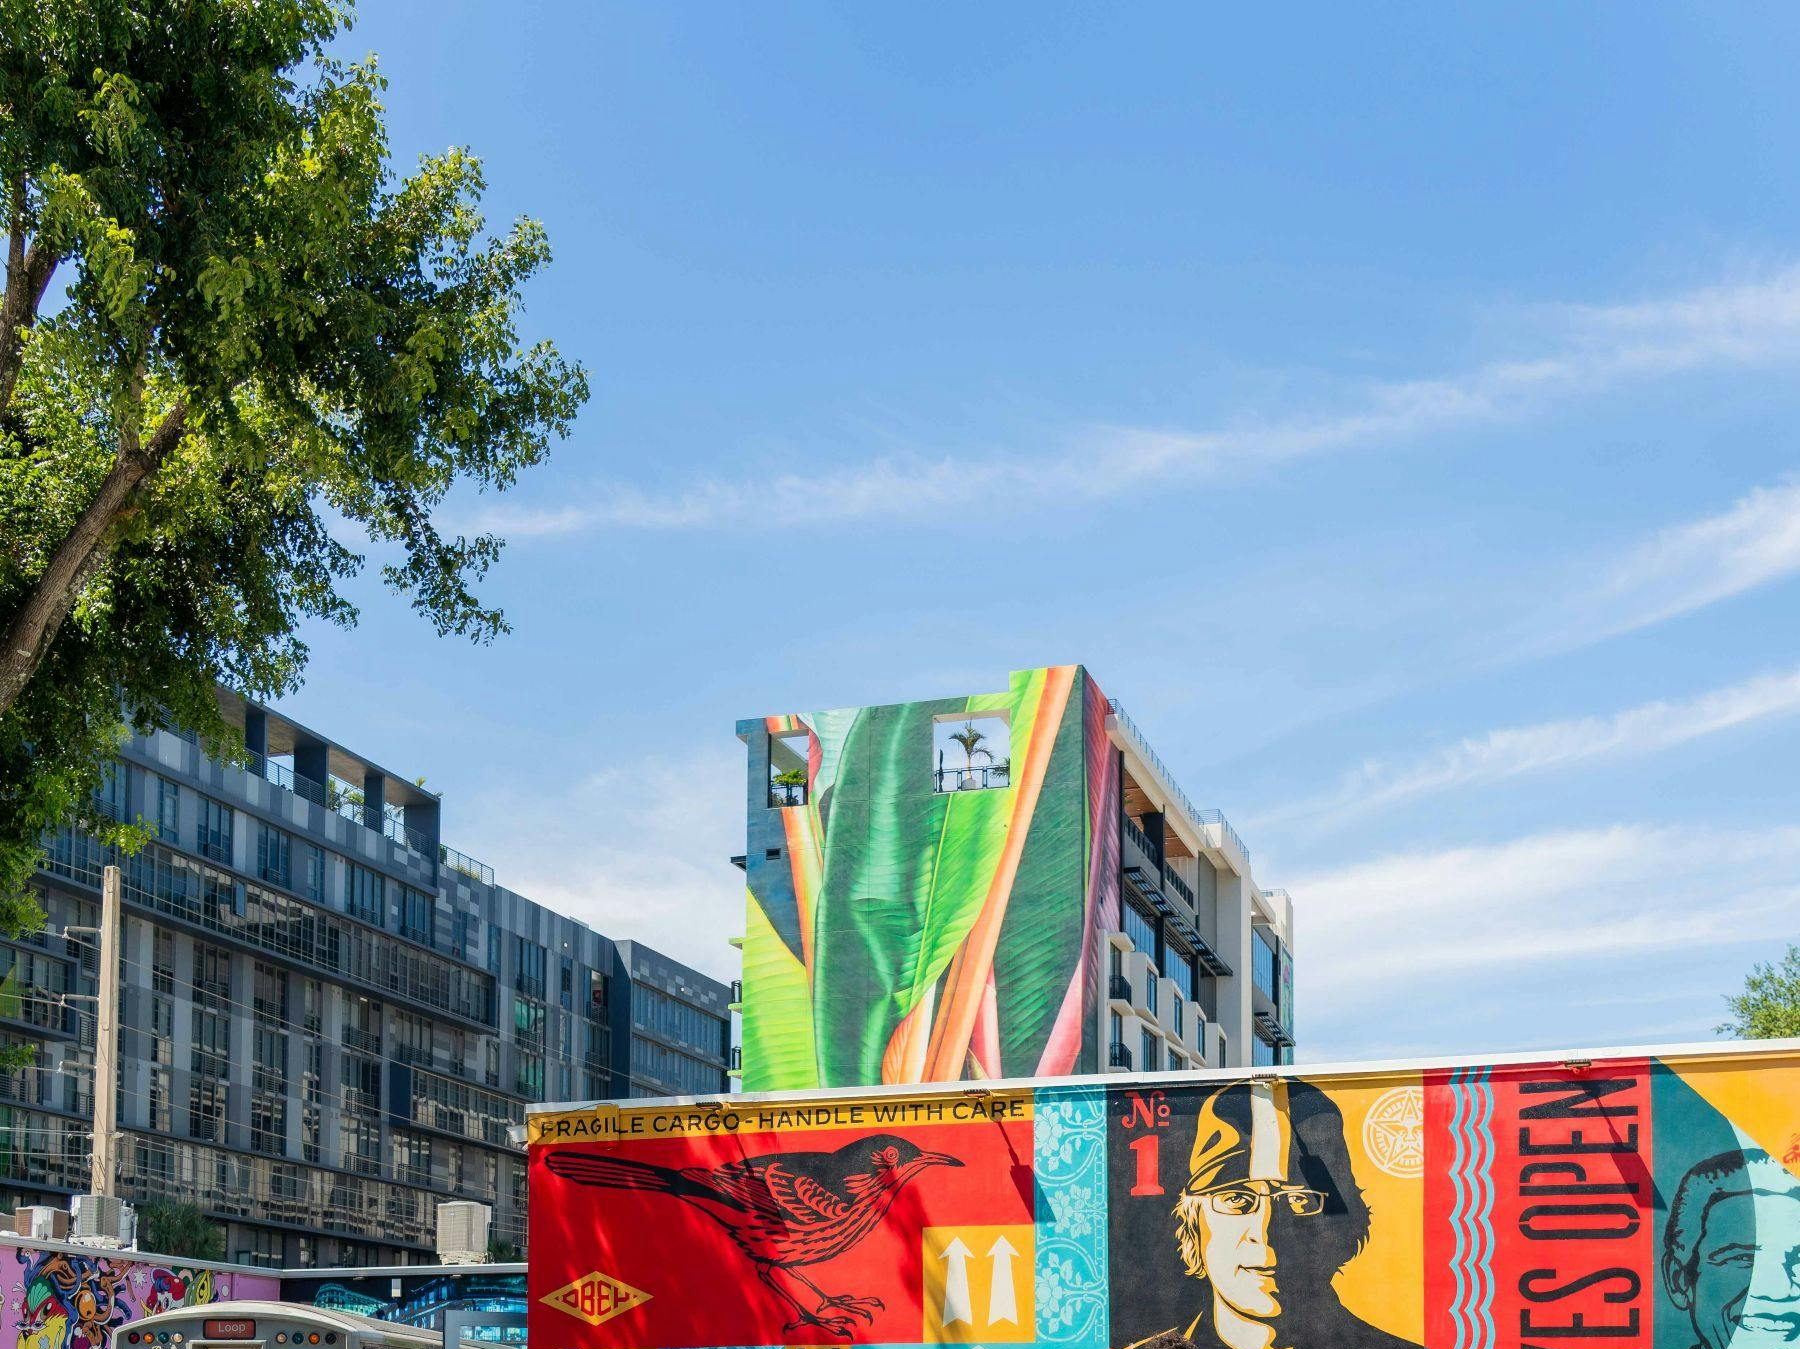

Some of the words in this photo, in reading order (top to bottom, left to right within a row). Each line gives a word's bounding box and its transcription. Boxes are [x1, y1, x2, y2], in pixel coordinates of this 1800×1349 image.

[541, 1116, 644, 1138] FRAGILE
[652, 1112, 740, 1133] CARGO
[758, 1106, 864, 1129] HANDLE
[873, 1102, 943, 1123] WITH
[952, 1099, 1025, 1120] CARE
[1129, 1134, 1165, 1196] 1
[1518, 1078, 1641, 1241] OPEN
[218, 1322, 246, 1334] Loop
